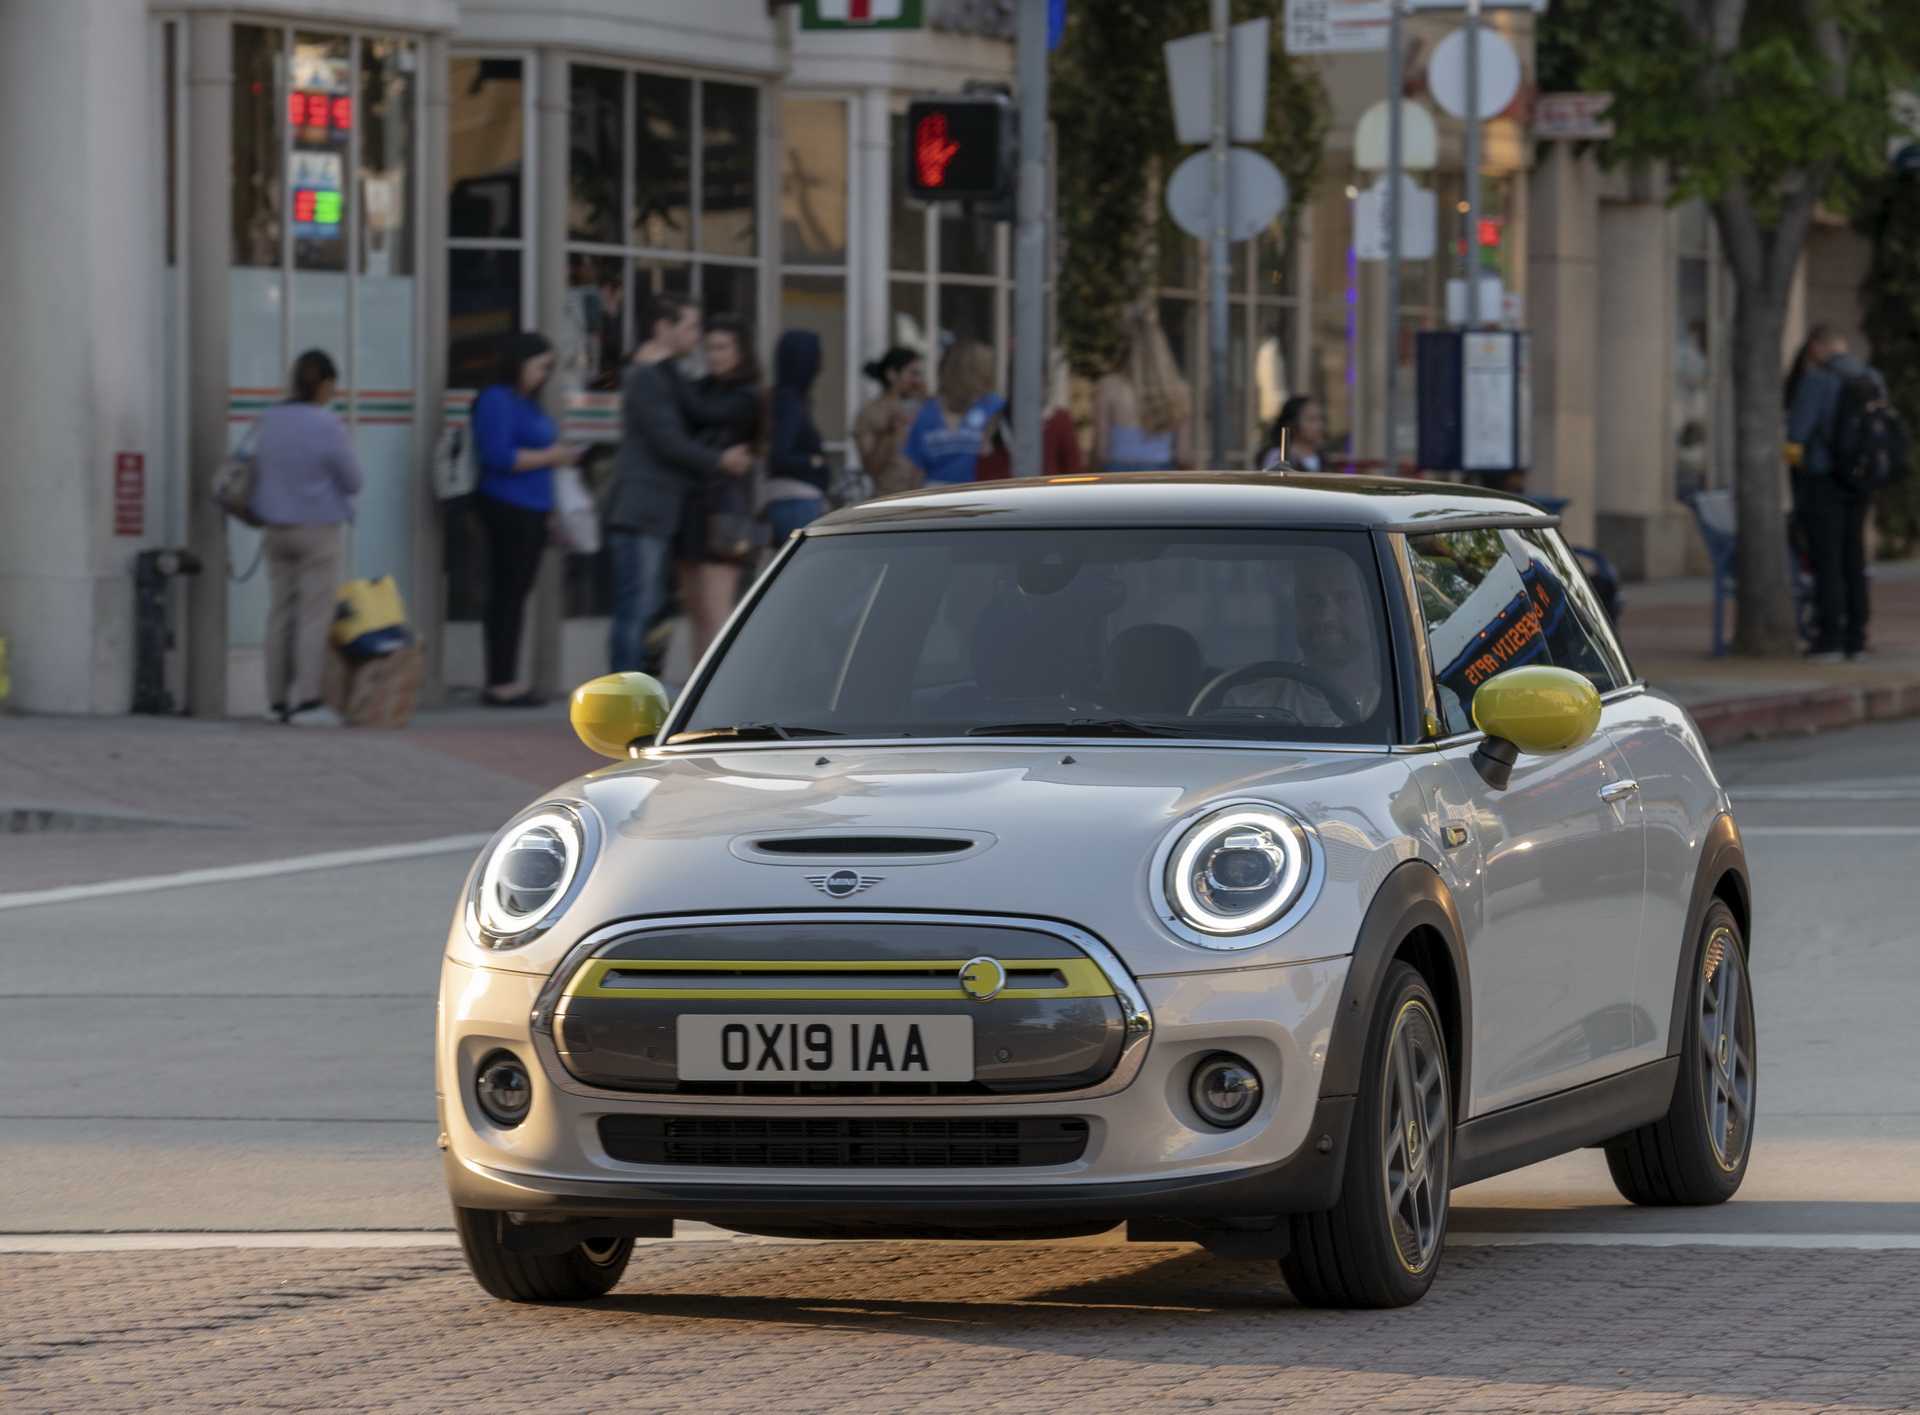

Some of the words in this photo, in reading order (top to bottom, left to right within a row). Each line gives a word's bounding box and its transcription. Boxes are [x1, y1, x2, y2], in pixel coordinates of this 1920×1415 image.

[827, 877, 857, 886] MINI
[721, 1023, 833, 1071] OX19
[850, 1023, 931, 1072] IAA
